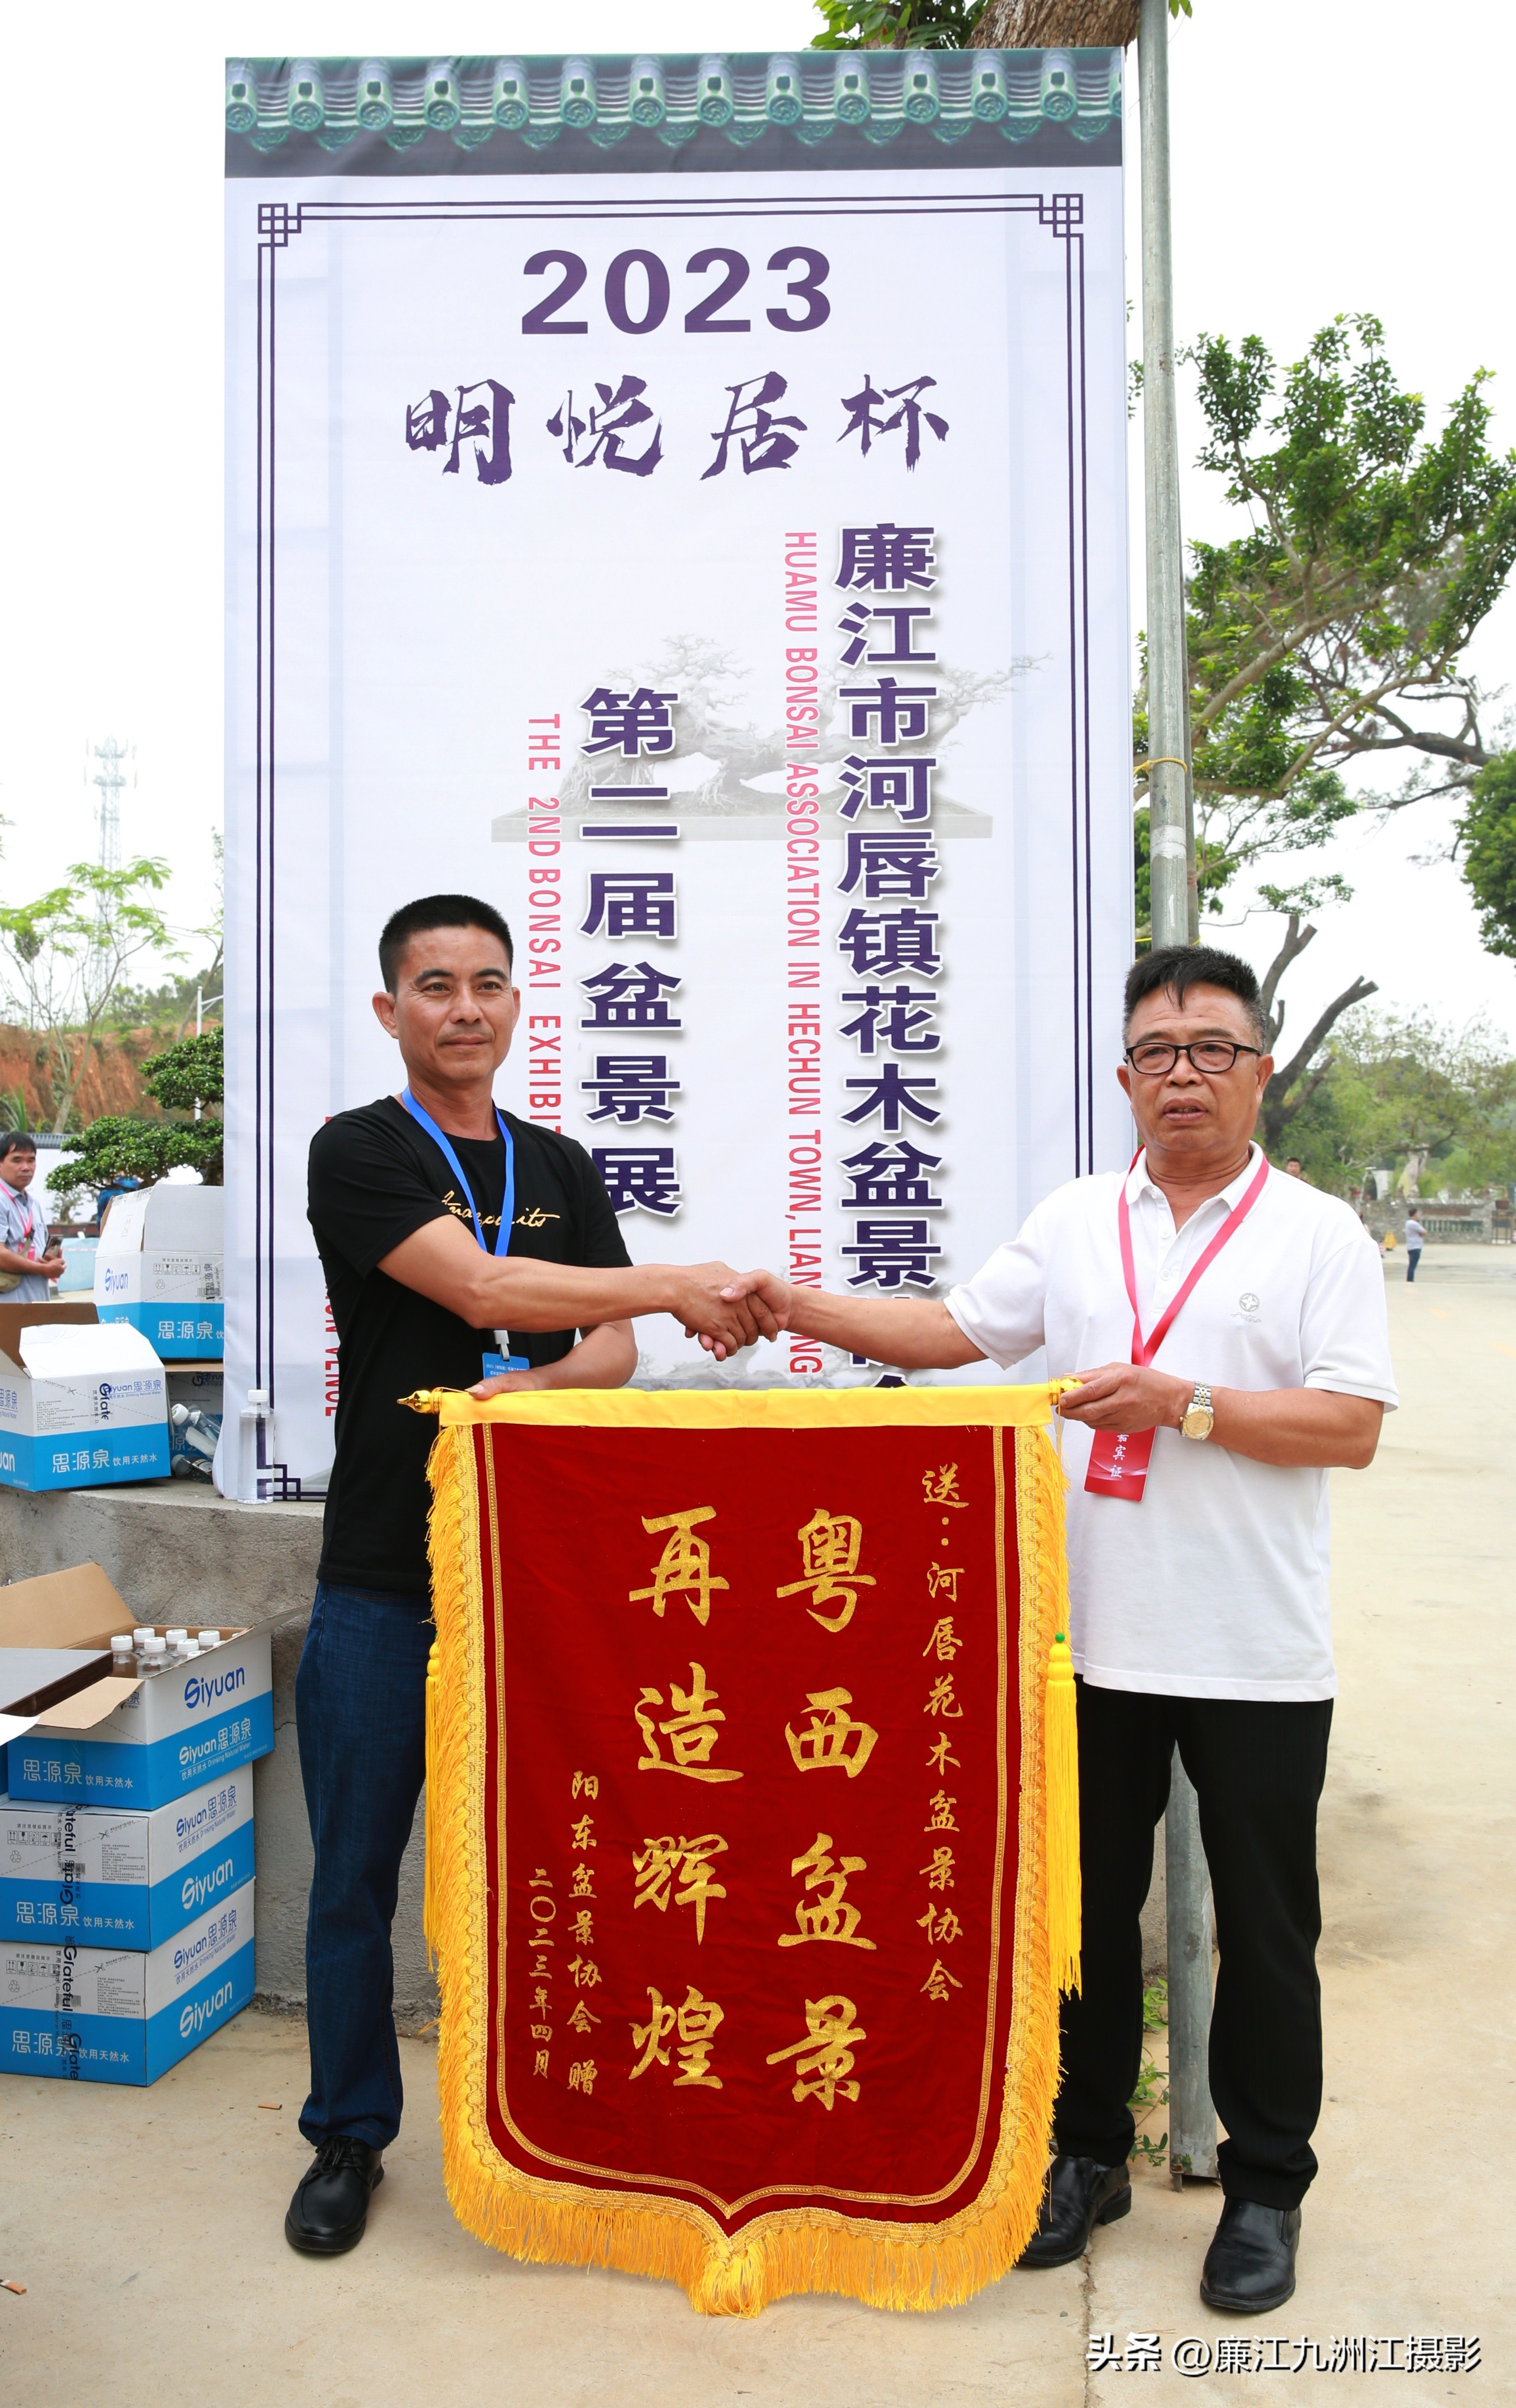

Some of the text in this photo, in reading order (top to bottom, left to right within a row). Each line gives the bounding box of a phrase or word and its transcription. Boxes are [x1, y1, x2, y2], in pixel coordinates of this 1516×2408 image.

[522, 246, 831, 334] 2023
[405, 371, 949, 485] 明悦居杯
[785, 532, 817, 632] HUAMU
[785, 648, 818, 749] BONSAI
[786, 764, 820, 947] ASSOCIATION
[528, 713, 561, 1134] THE 2ND BONSAI EXHIBI
[579, 687, 683, 1216] 第二届盆景展
[834, 522, 943, 1388] 廉江市河唇镇花木盆景
[788, 962, 820, 988] IN
[788, 1004, 821, 1115] HECHUN
[785, 1129, 822, 1221] TOWN,
[104, 1268, 129, 1295] Siyuan
[158, 1321, 213, 1339] 思源泉
[133, 1380, 162, 1391] 思源泉
[52, 1449, 158, 1474] 思源泉 饮用天然水
[184, 1667, 245, 1709] Siyuan
[218, 1718, 251, 1751] 思源泉
[179, 1738, 217, 1765] Siyuan
[208, 1753, 225, 1767] Drinking
[225, 1748, 239, 1760] Natural
[239, 1742, 251, 1751] Water
[23, 1759, 133, 1788] 思源泉 饮用天然水
[181, 1763, 207, 1781] 饮用天然水
[208, 1785, 237, 1820] 思源泉
[628, 1505, 744, 2089] 再造辉煌
[765, 1508, 879, 2111] 粤西盆景
[176, 1809, 207, 1837] Siyuan
[214, 1817, 226, 1829] Natural
[178, 1835, 201, 1853] 饮用天然水
[182, 1859, 233, 1910] Siyuan
[17, 1901, 135, 1929] 思源泉 饮用天然水
[208, 1909, 237, 1948] 思源泉
[173, 1937, 207, 1969] Siyuan
[214, 1942, 227, 1955] Natural
[176, 1963, 199, 1985] 饮用天然水
[179, 1981, 233, 2038] Siyuan
[79, 2048, 129, 2063] 饮用天然水
